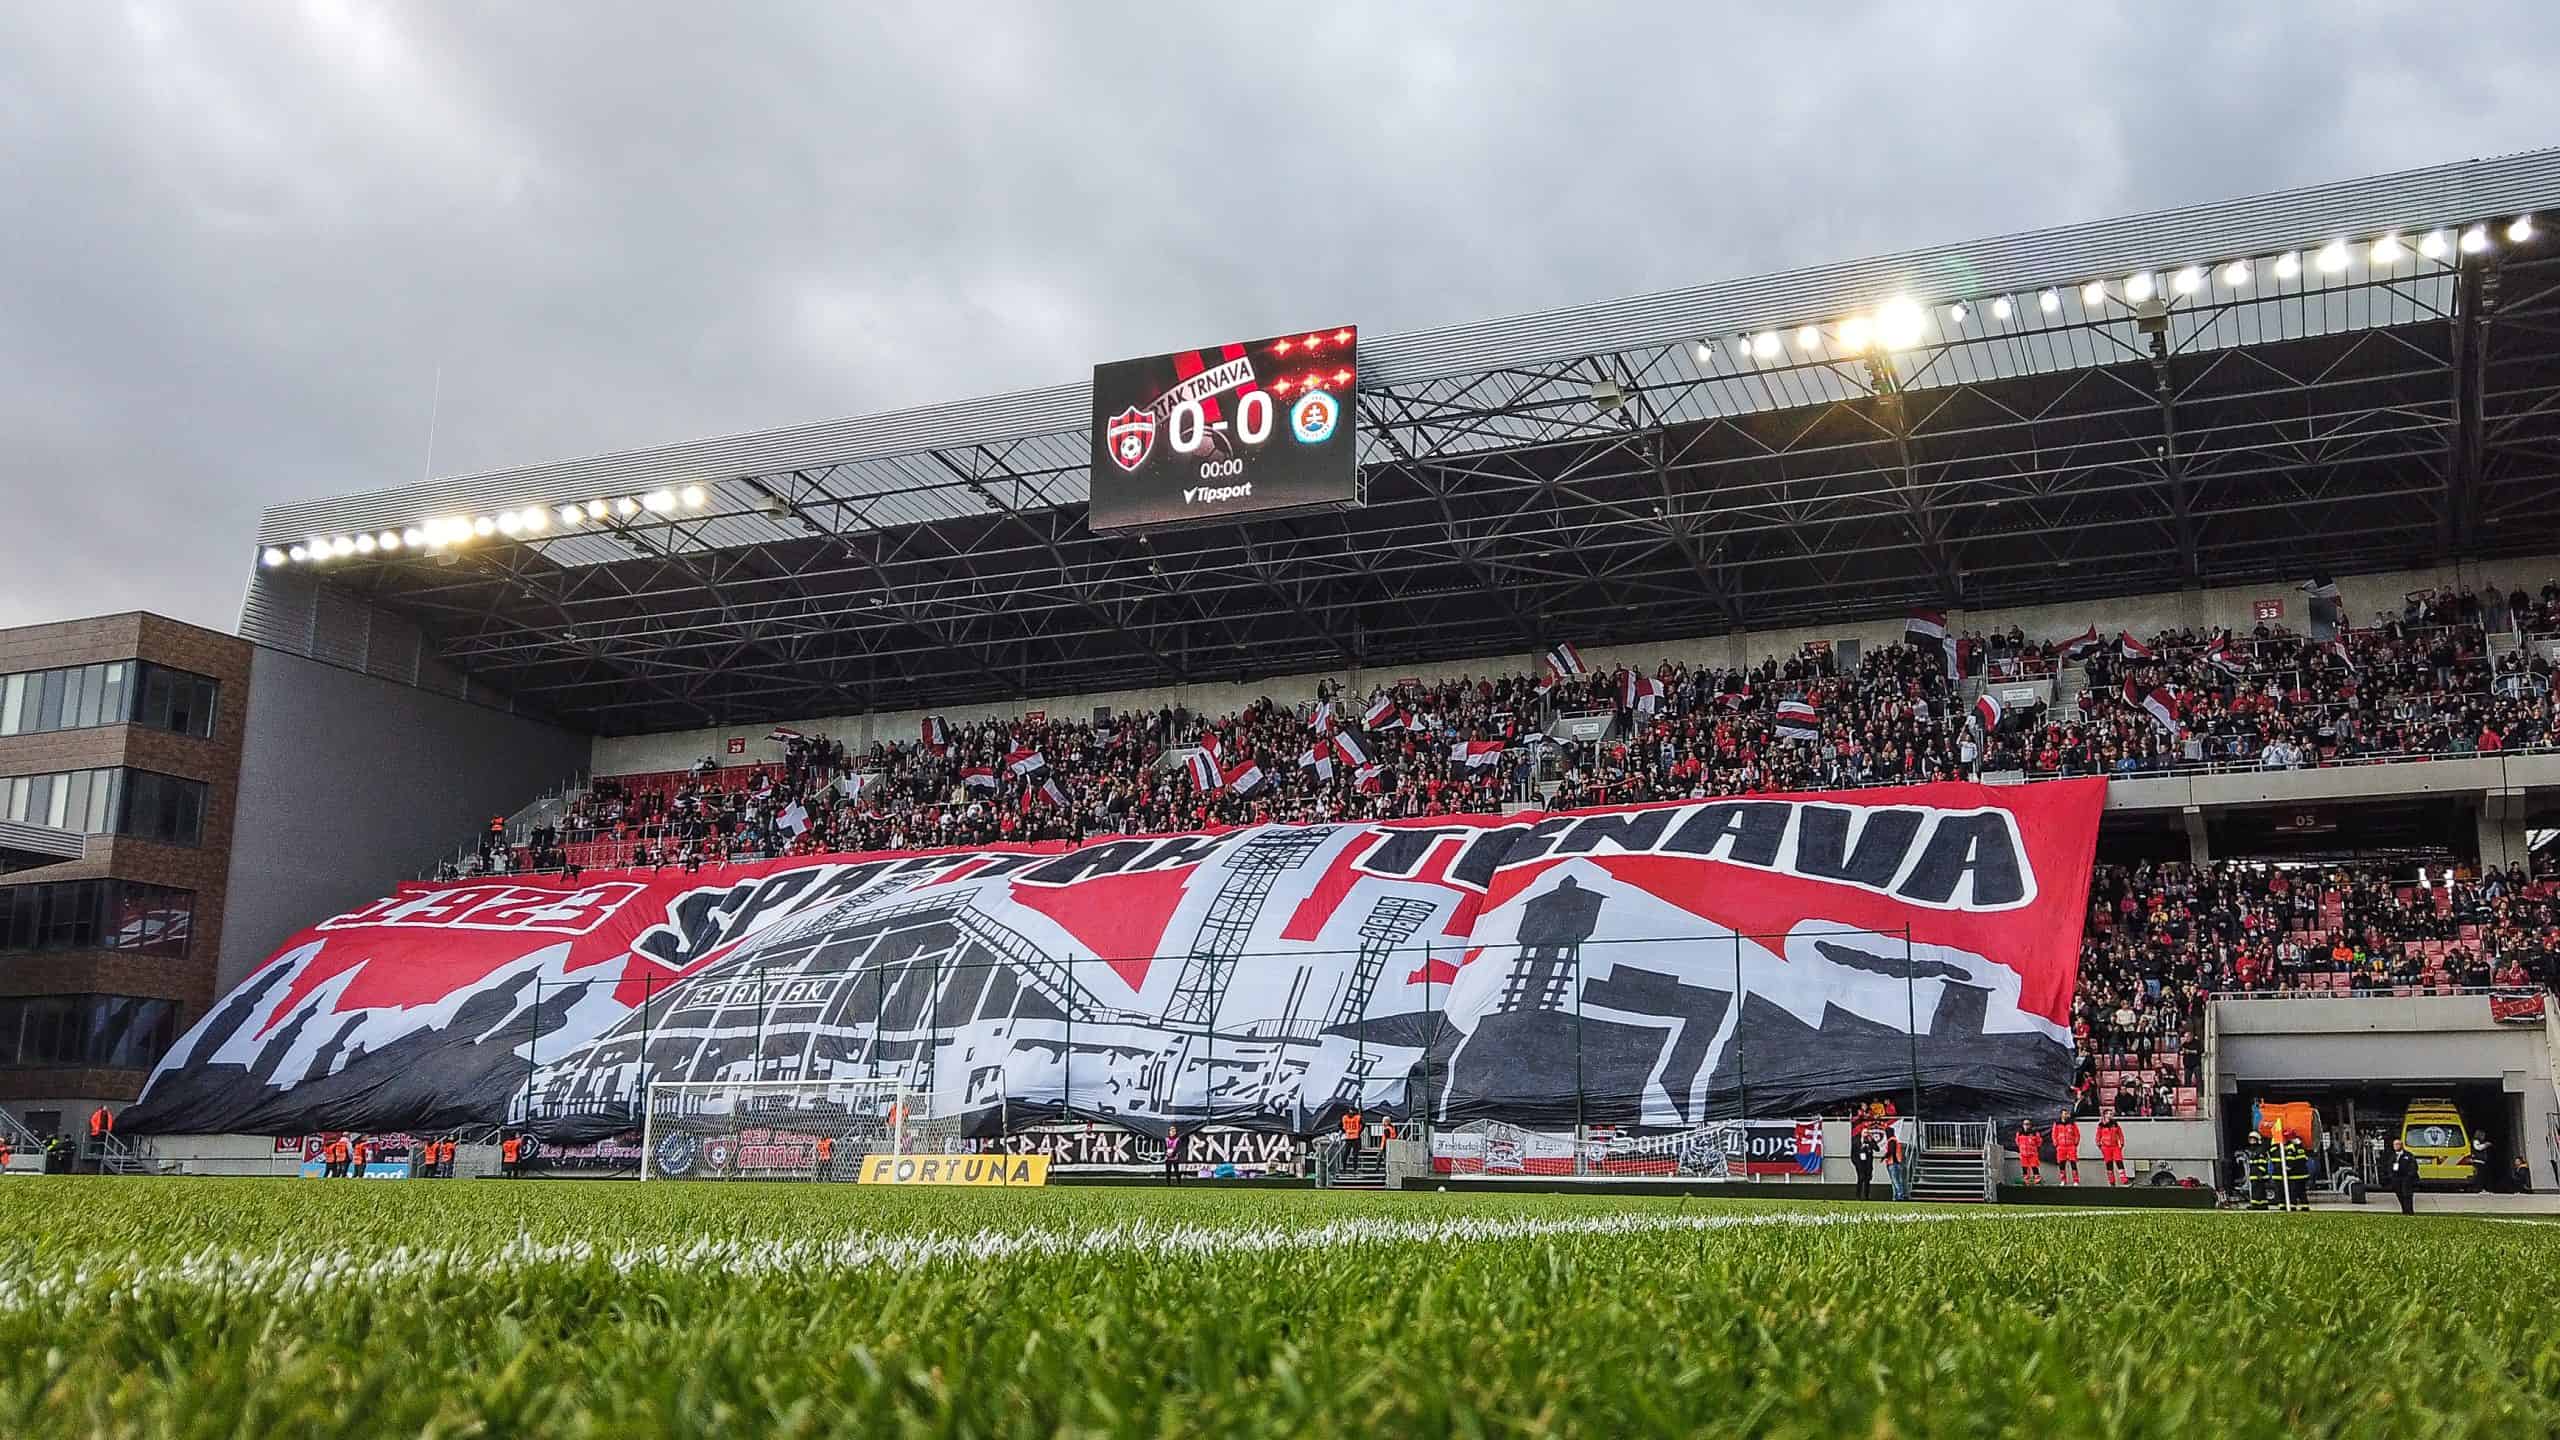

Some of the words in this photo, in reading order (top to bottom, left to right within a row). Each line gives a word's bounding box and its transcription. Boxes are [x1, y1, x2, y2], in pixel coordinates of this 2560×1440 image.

[1188, 361, 1251, 399] TRNAVA
[1200, 458, 1243, 479] 00:00
[1197, 482, 1252, 503] Tipsport
[2259, 608, 2277, 619] 33
[2295, 815, 2315, 827] 05
[630, 829, 1245, 972] SPARTAK
[1349, 802, 2037, 912] TRNAVA
[315, 882, 648, 935] 1923
[873, 1160, 1030, 1182] FORTUNA
